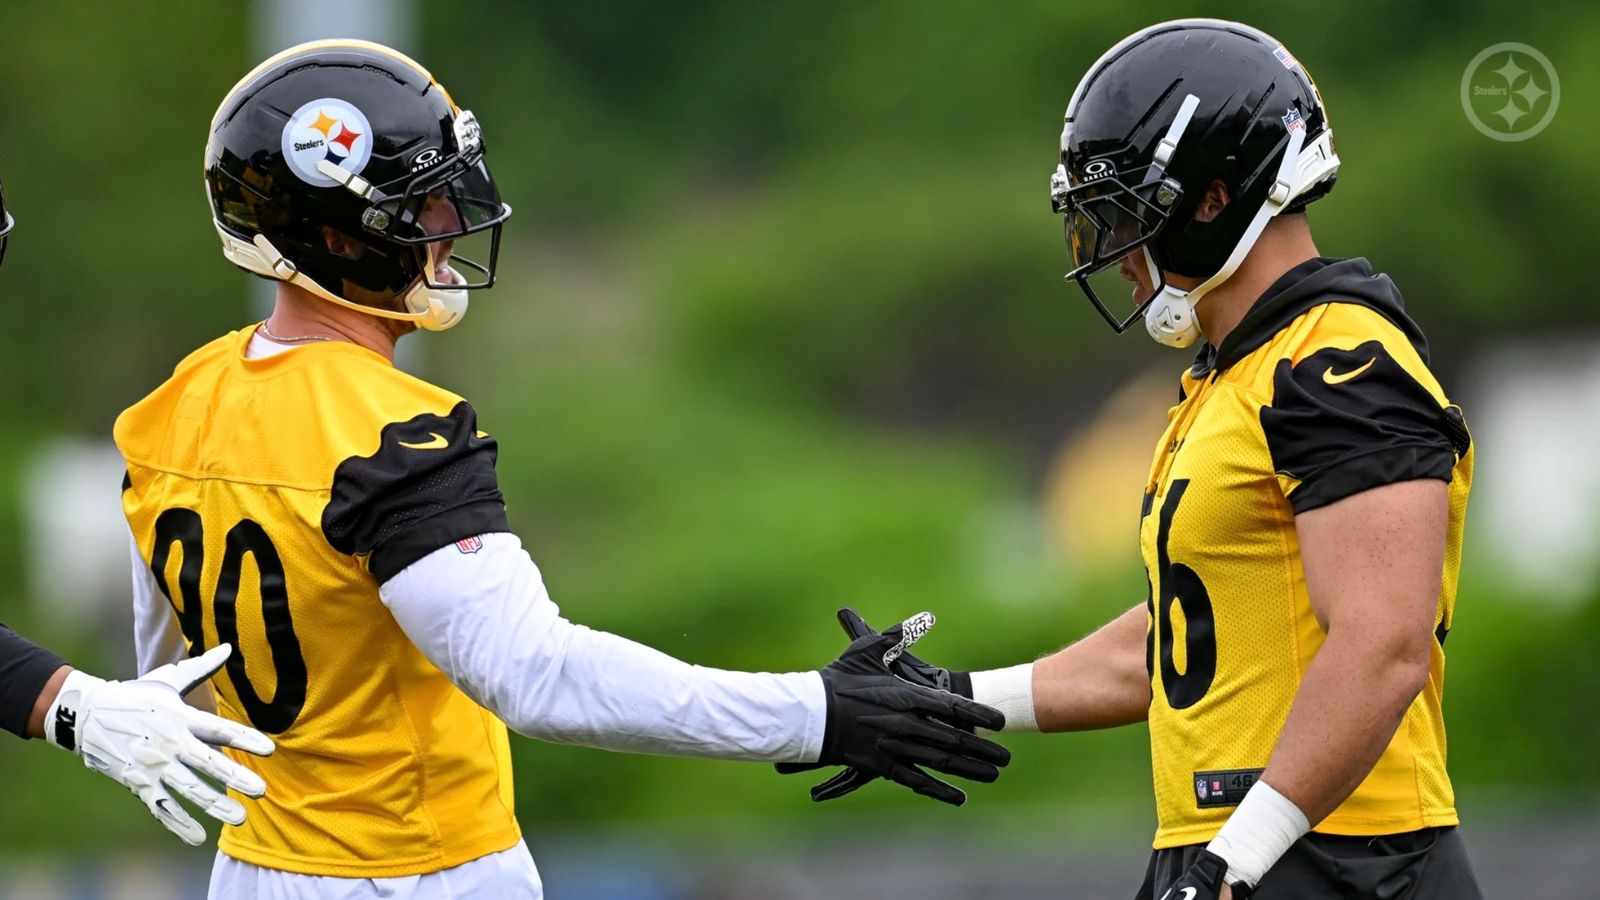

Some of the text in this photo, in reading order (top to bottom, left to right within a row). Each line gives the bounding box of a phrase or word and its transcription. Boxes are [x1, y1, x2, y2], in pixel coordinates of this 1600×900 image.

[293, 139, 325, 152] Steelers
[412, 155, 443, 173] OAKLEY
[1083, 169, 1114, 182] OAKLEY
[151, 507, 308, 734] 90
